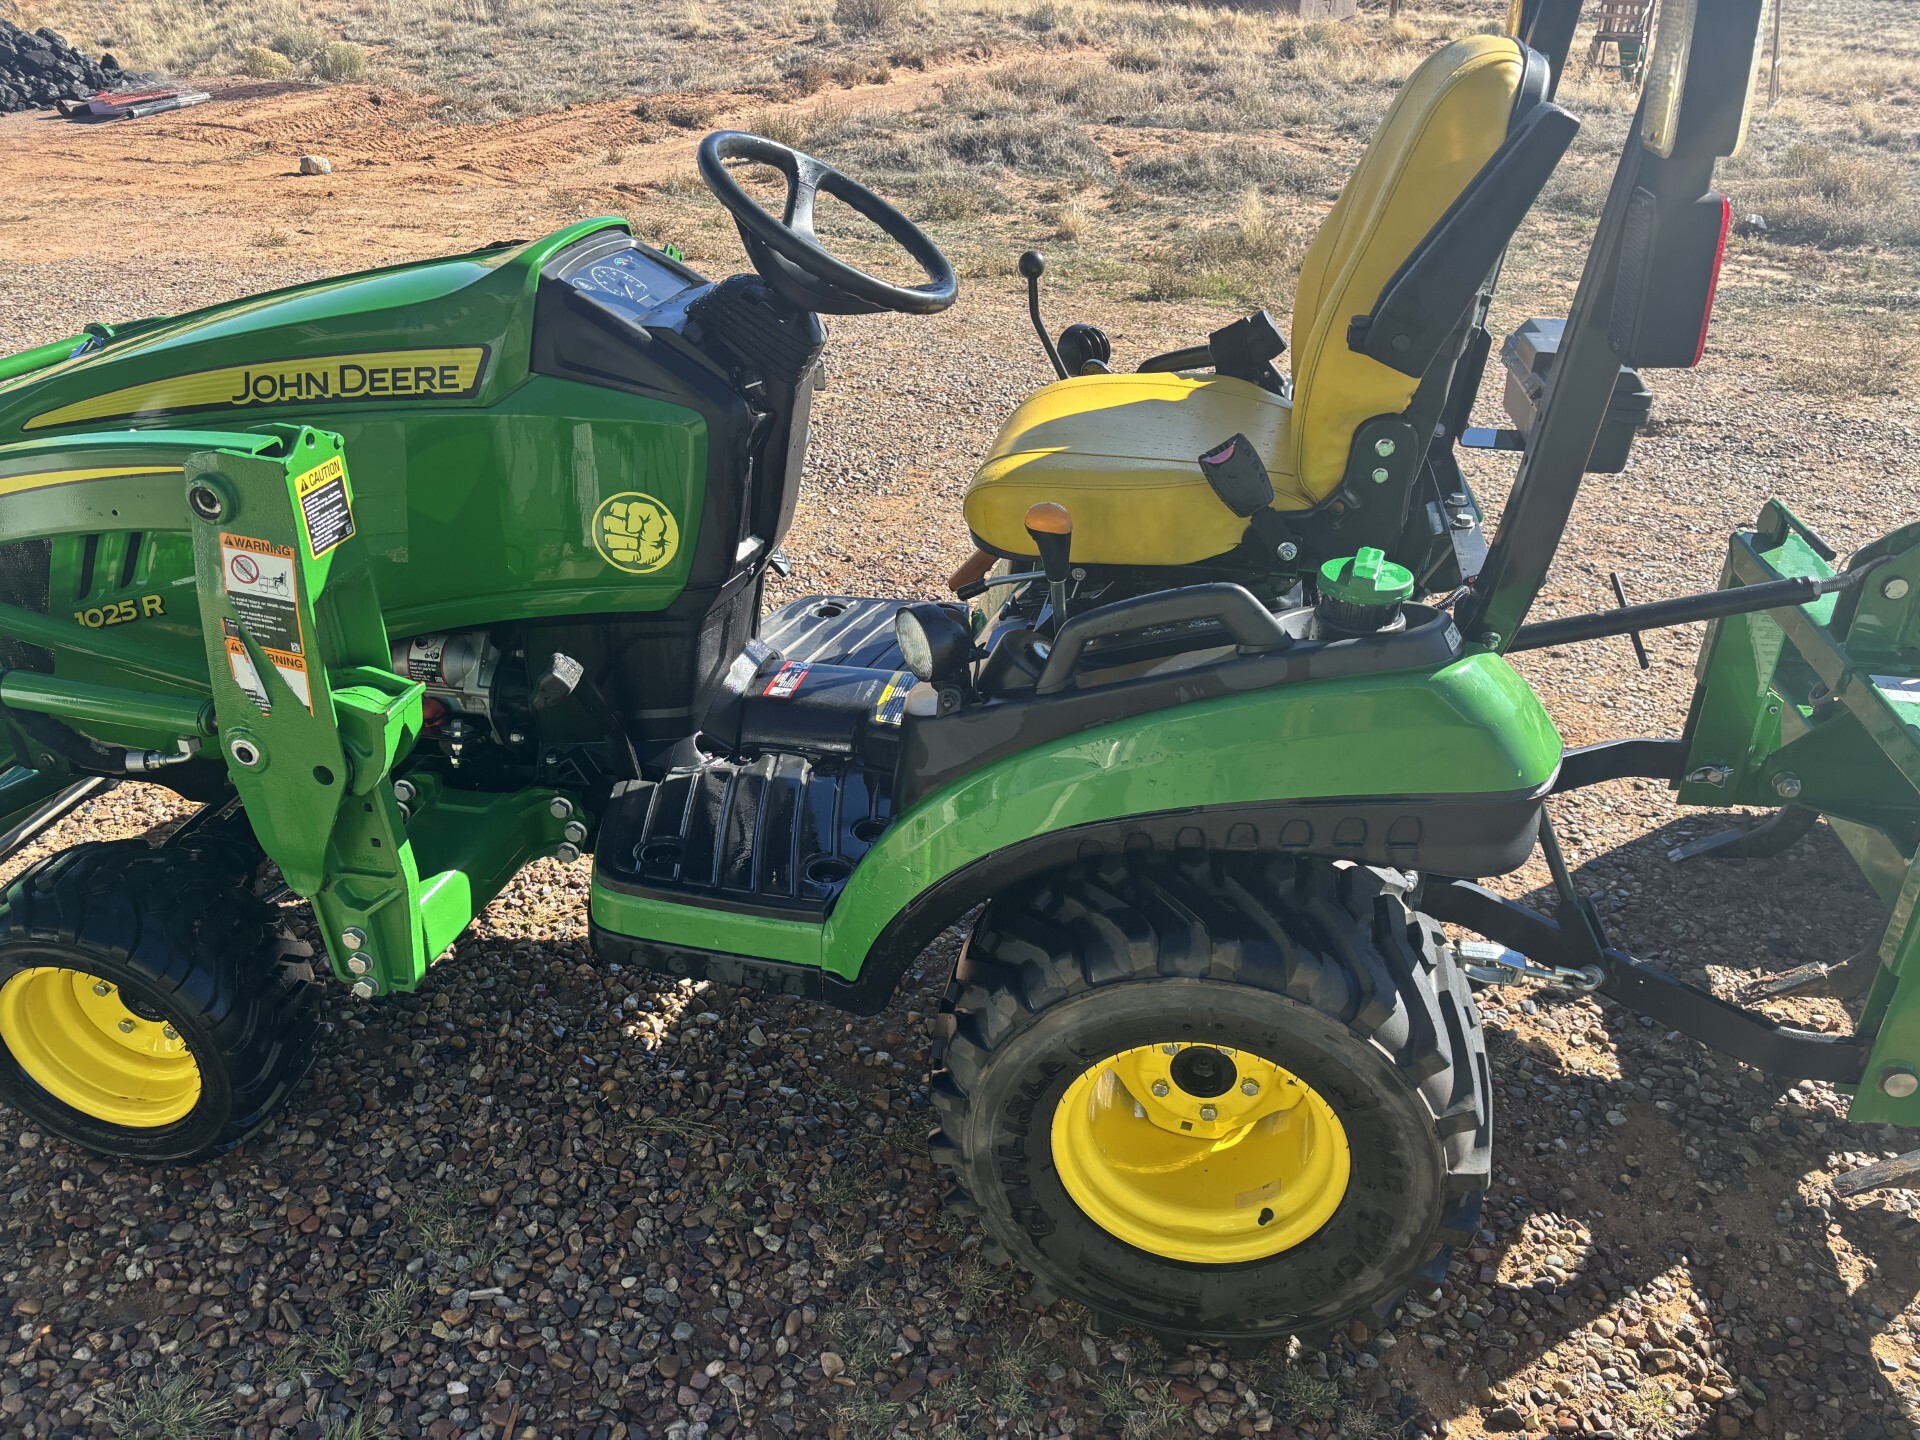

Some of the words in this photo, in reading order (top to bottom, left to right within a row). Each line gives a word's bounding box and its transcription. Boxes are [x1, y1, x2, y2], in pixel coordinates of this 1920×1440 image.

[232, 371, 330, 401] JOHN
[339, 364, 460, 393] DEERE
[308, 460, 341, 487] CAUTION
[234, 536, 292, 557] WARNING
[73, 599, 138, 628] 1025
[141, 594, 165, 617] R
